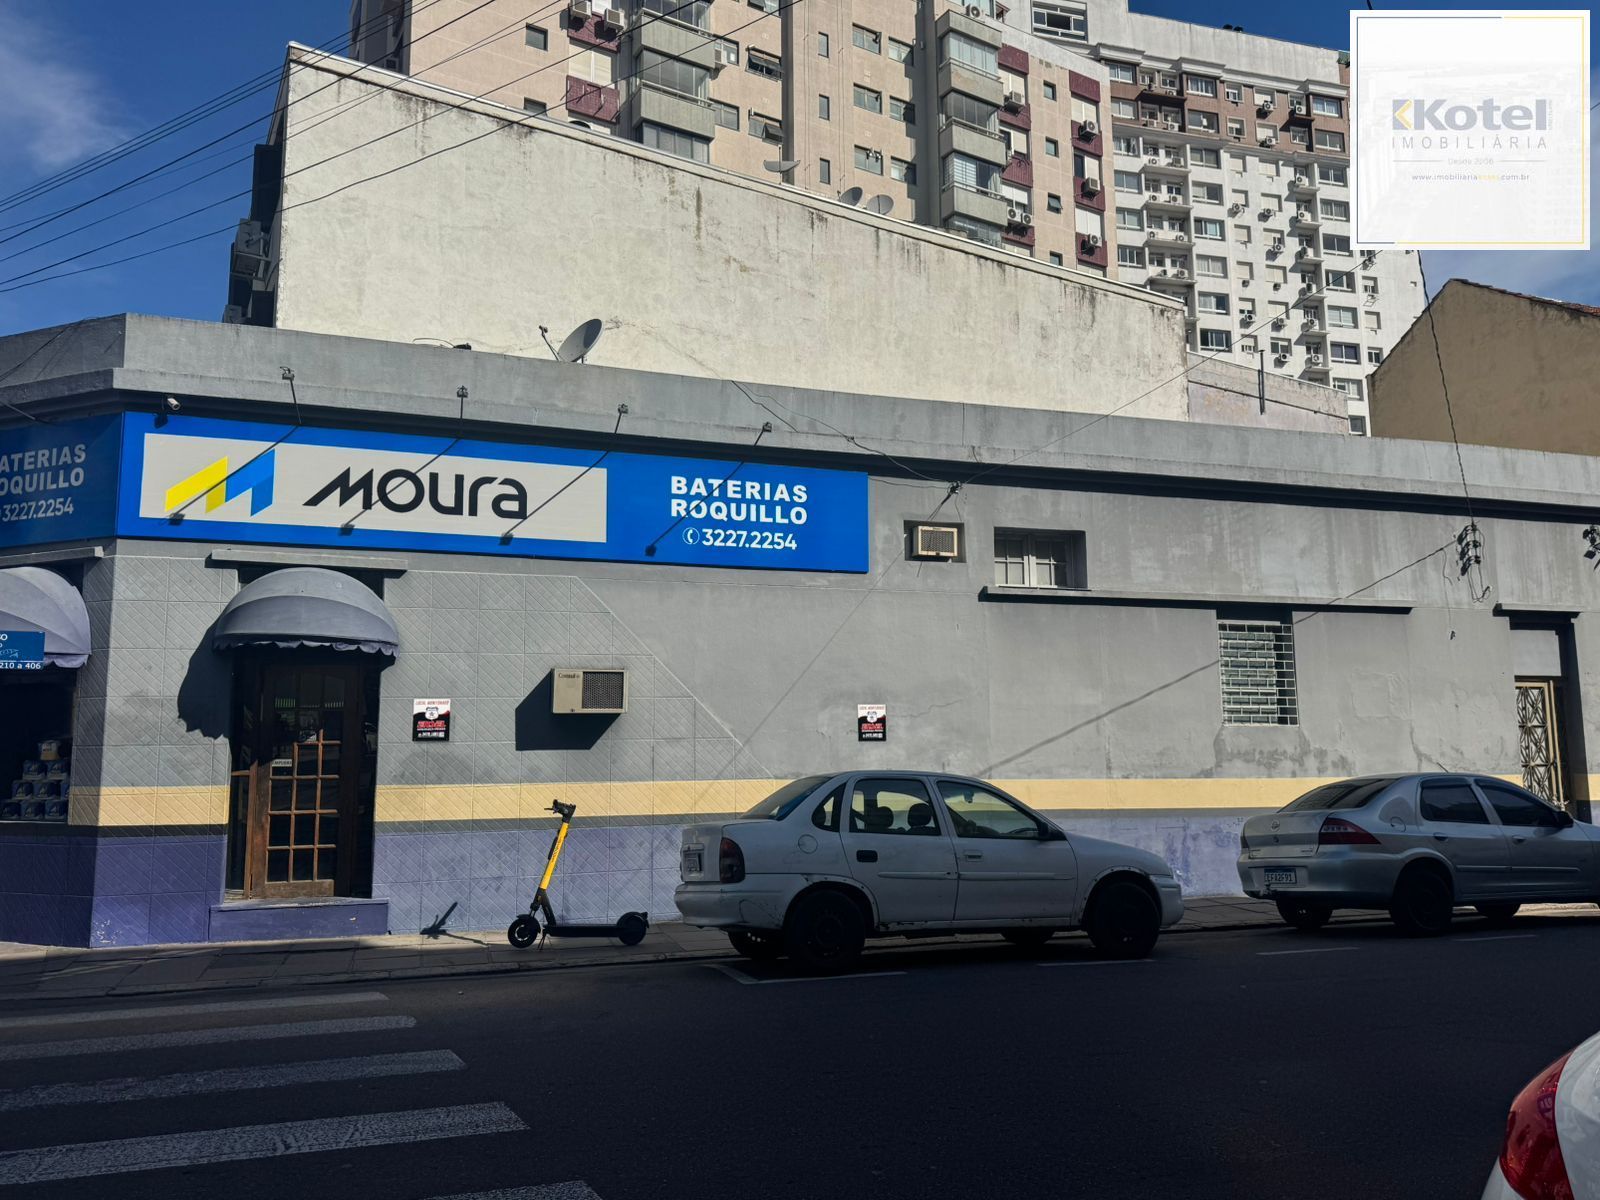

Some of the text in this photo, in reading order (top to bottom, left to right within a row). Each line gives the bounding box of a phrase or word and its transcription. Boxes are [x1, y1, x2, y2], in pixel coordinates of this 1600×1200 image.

[671, 476, 808, 503] BATERIAS
[2, 497, 75, 522] 3227.2254
[671, 499, 808, 525] ROQUILLO
[702, 528, 798, 550] 3227.2254
